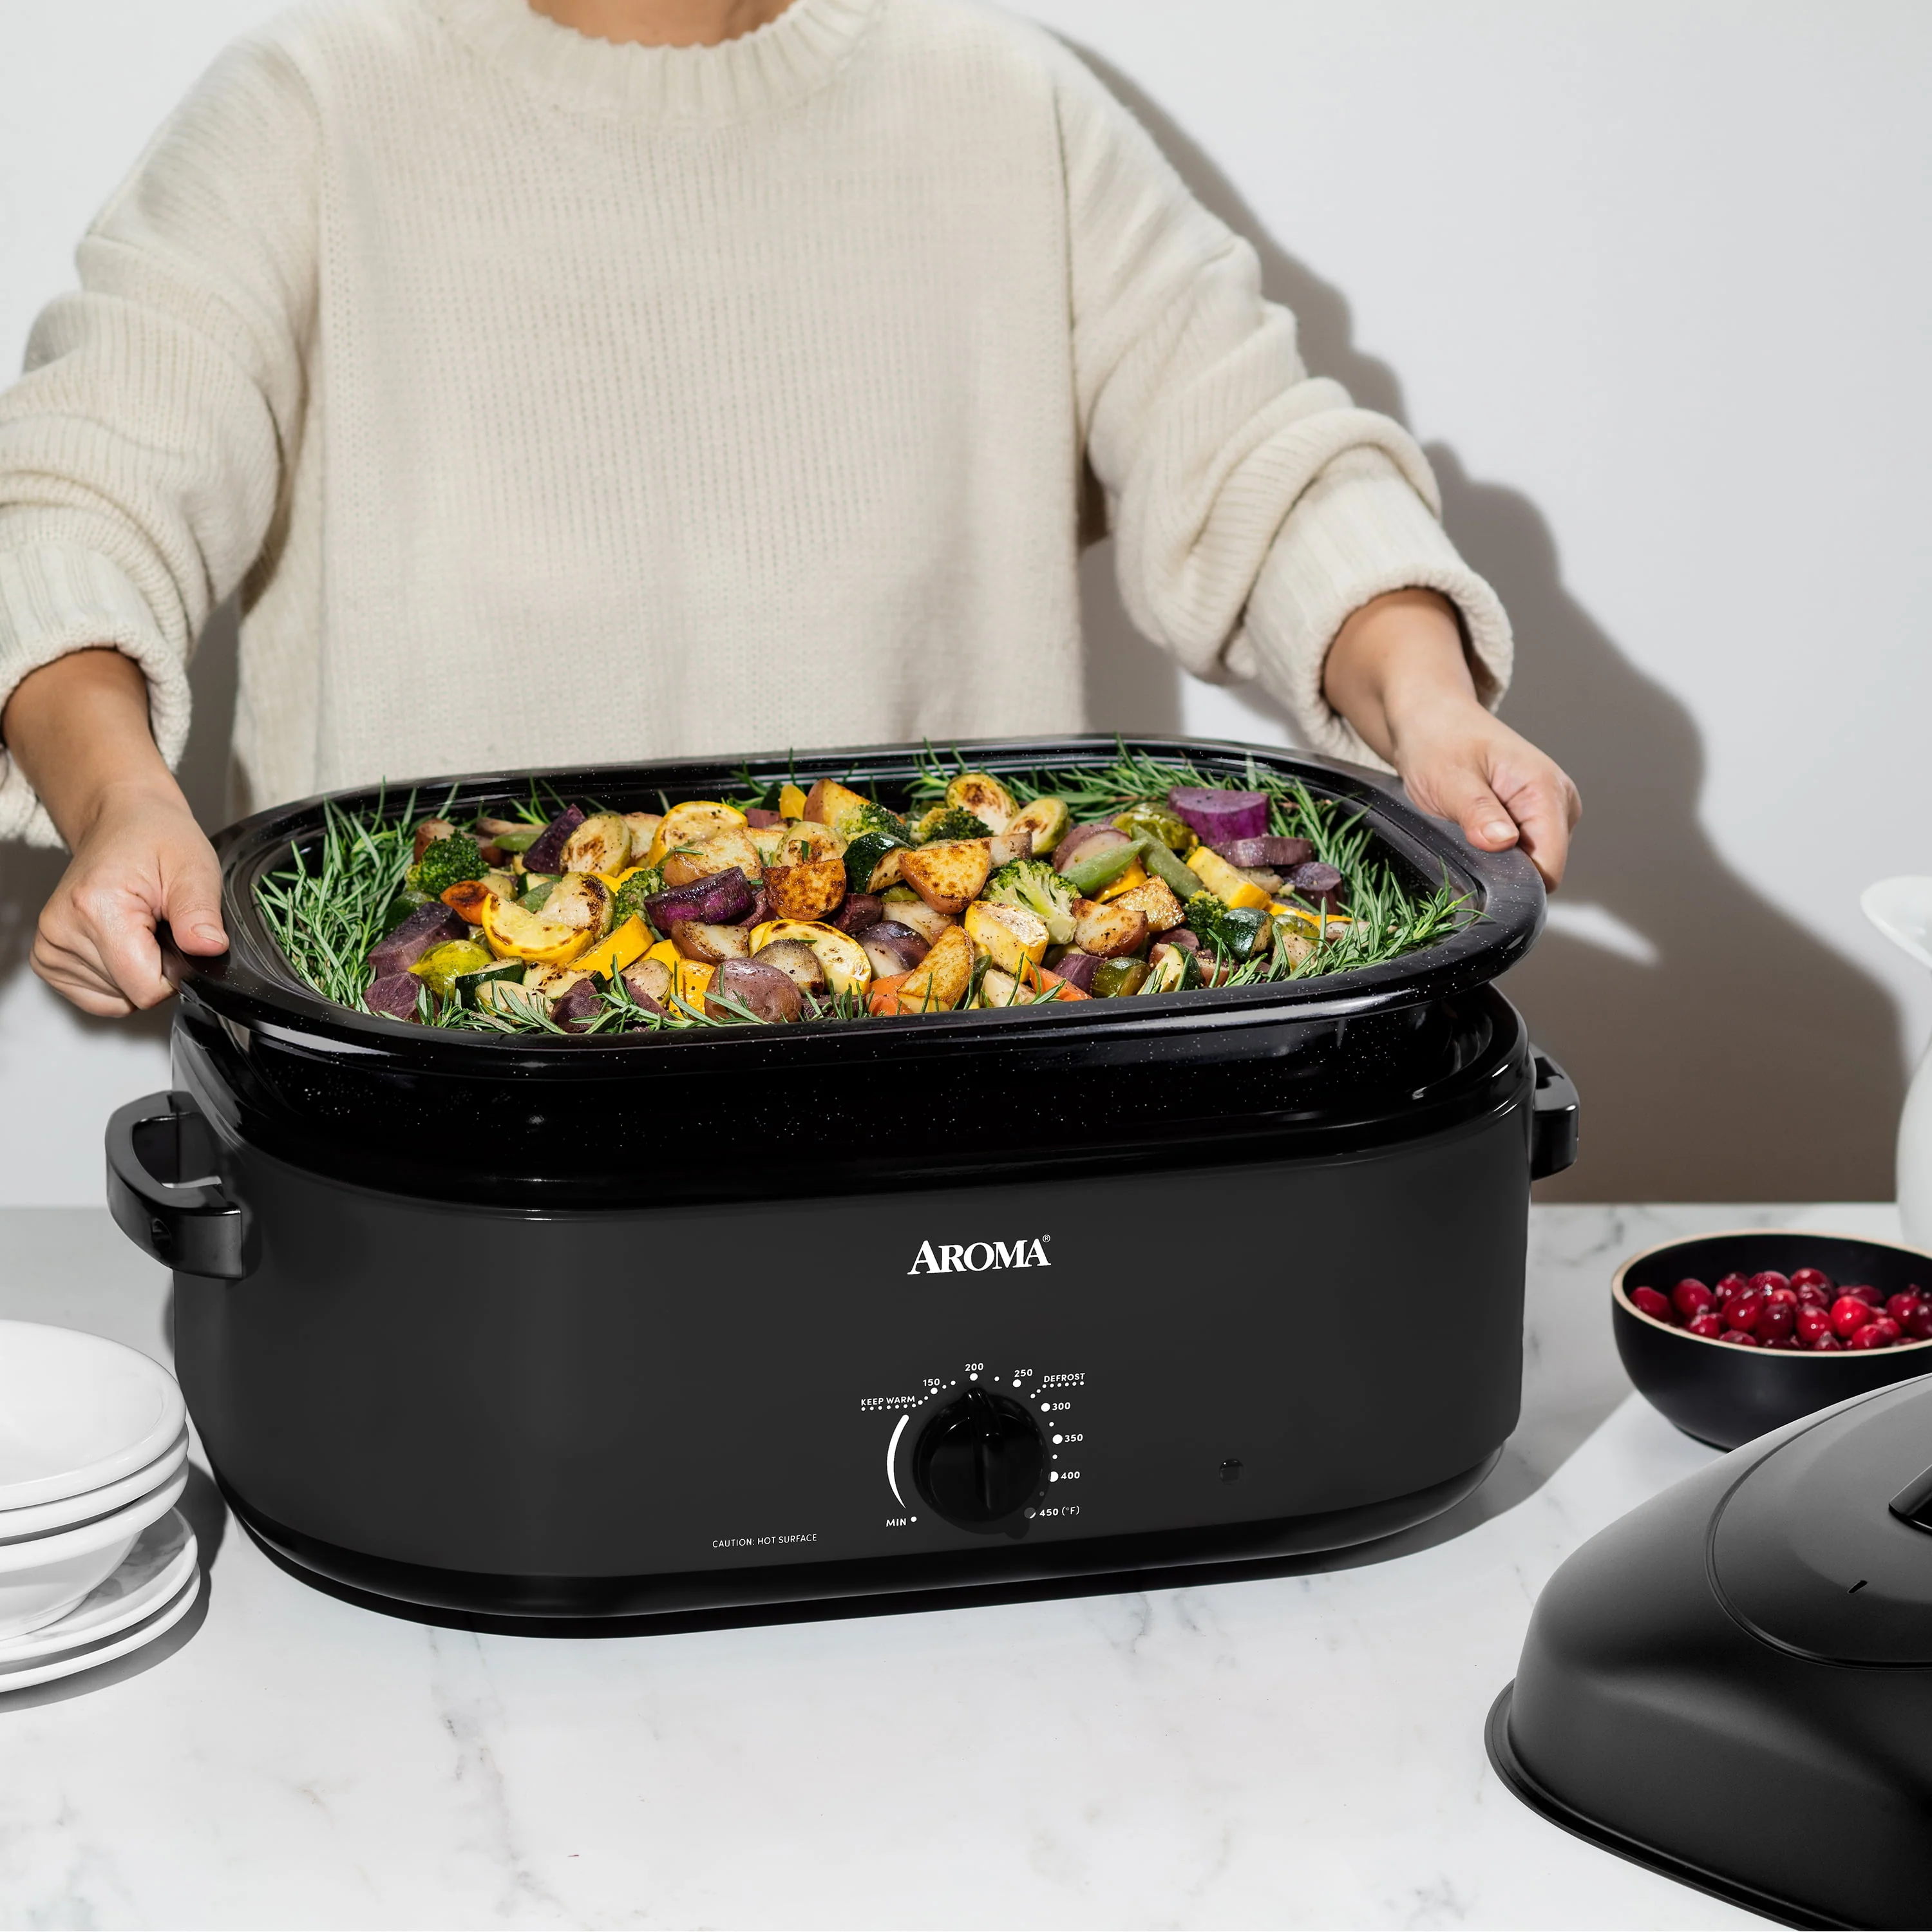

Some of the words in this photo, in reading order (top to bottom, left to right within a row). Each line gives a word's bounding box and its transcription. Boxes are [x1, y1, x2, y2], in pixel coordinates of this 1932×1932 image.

[965, 1363, 984, 1372] 200
[1014, 1368, 1033, 1378] 250
[1043, 1372, 1085, 1383] DEFROST
[922, 1378, 940, 1387] 150
[861, 1397, 884, 1406] KEEP
[886, 1396, 915, 1404] WARM
[1052, 1402, 1071, 1411] 300
[1065, 1434, 1083, 1443] 350
[1061, 1471, 1080, 1479] 400
[1039, 1508, 1059, 1517] 450
[886, 1518, 906, 1527] MIN
[712, 1538, 755, 1548] CAUTION:
[757, 1536, 776, 1545] HOT
[778, 1533, 817, 1544] SURFACE
